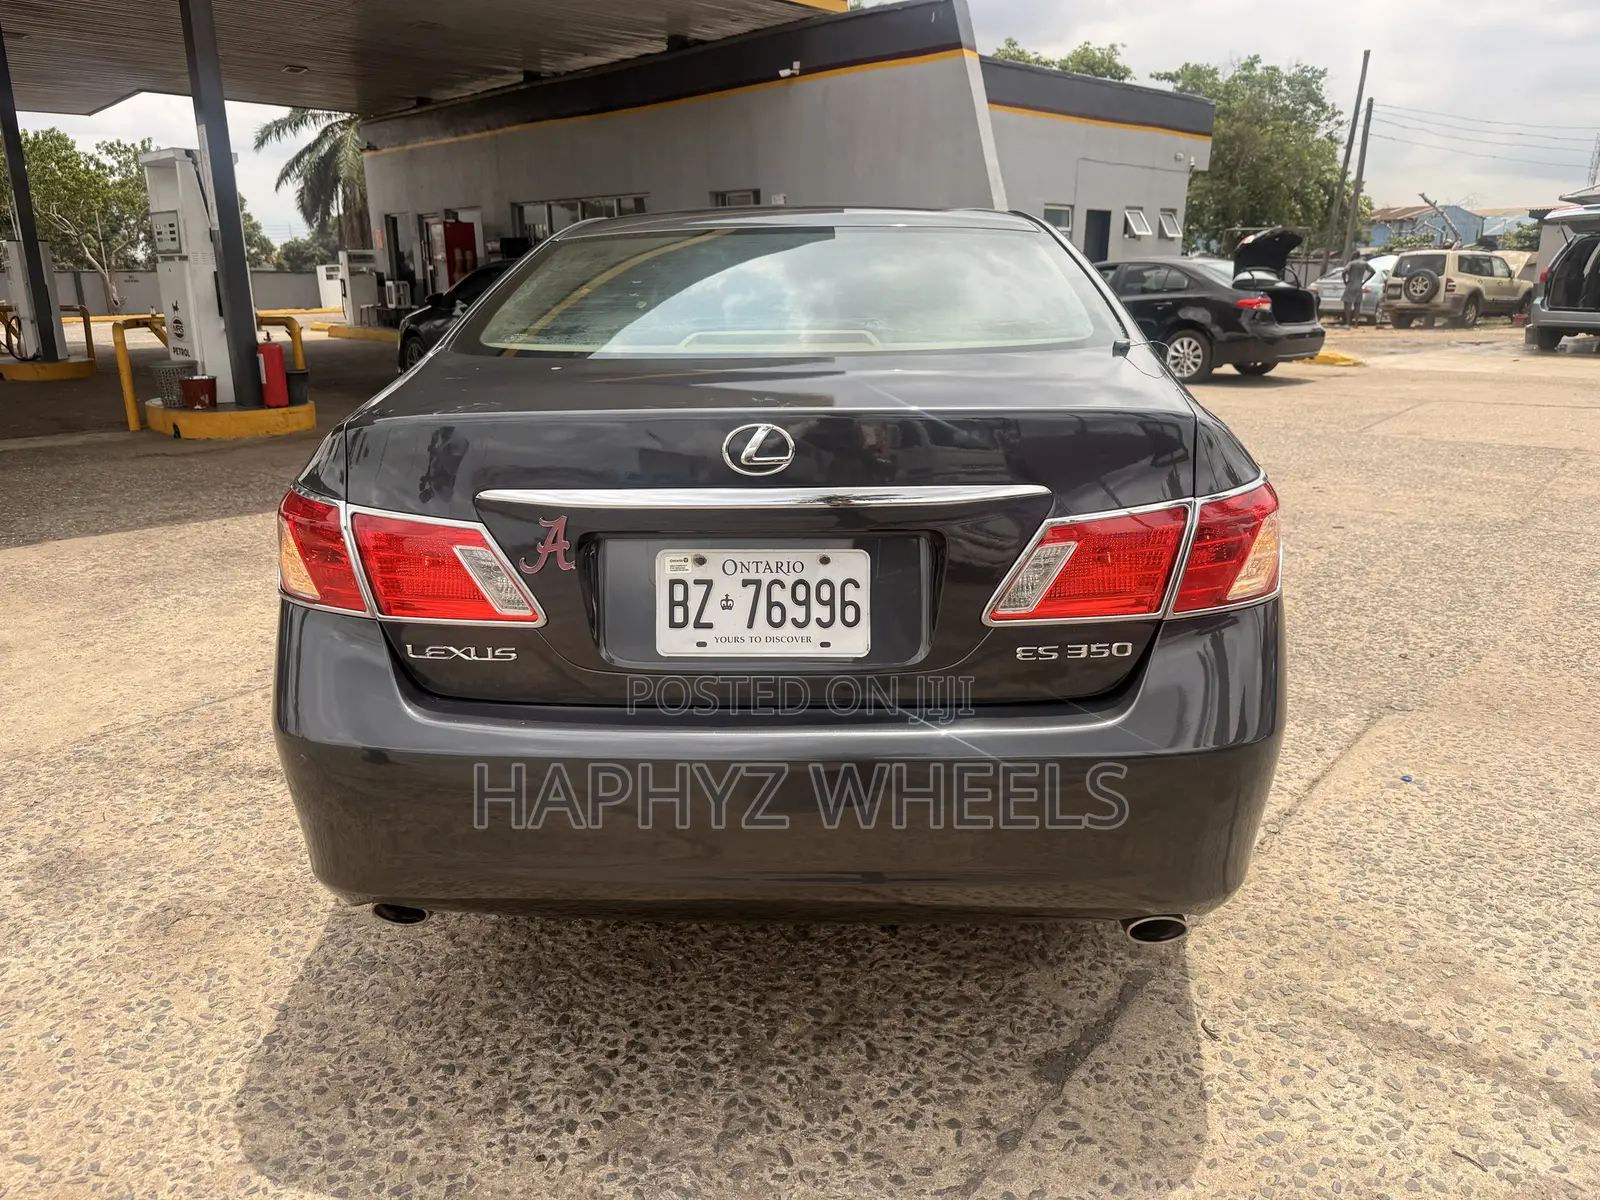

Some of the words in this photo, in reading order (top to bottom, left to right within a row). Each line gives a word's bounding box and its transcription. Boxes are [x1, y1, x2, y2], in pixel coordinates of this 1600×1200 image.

[172, 346, 191, 358] PETROL
[722, 558, 805, 577] ONTARIO
[668, 578, 714, 629] BZ
[741, 577, 861, 629] 76996
[714, 635, 746, 644] YOURS
[748, 635, 762, 644] TO
[765, 635, 813, 644] DISCOVER
[405, 644, 518, 662] LEXUS
[1015, 645, 1060, 661] ES
[1066, 642, 1133, 659] 350
